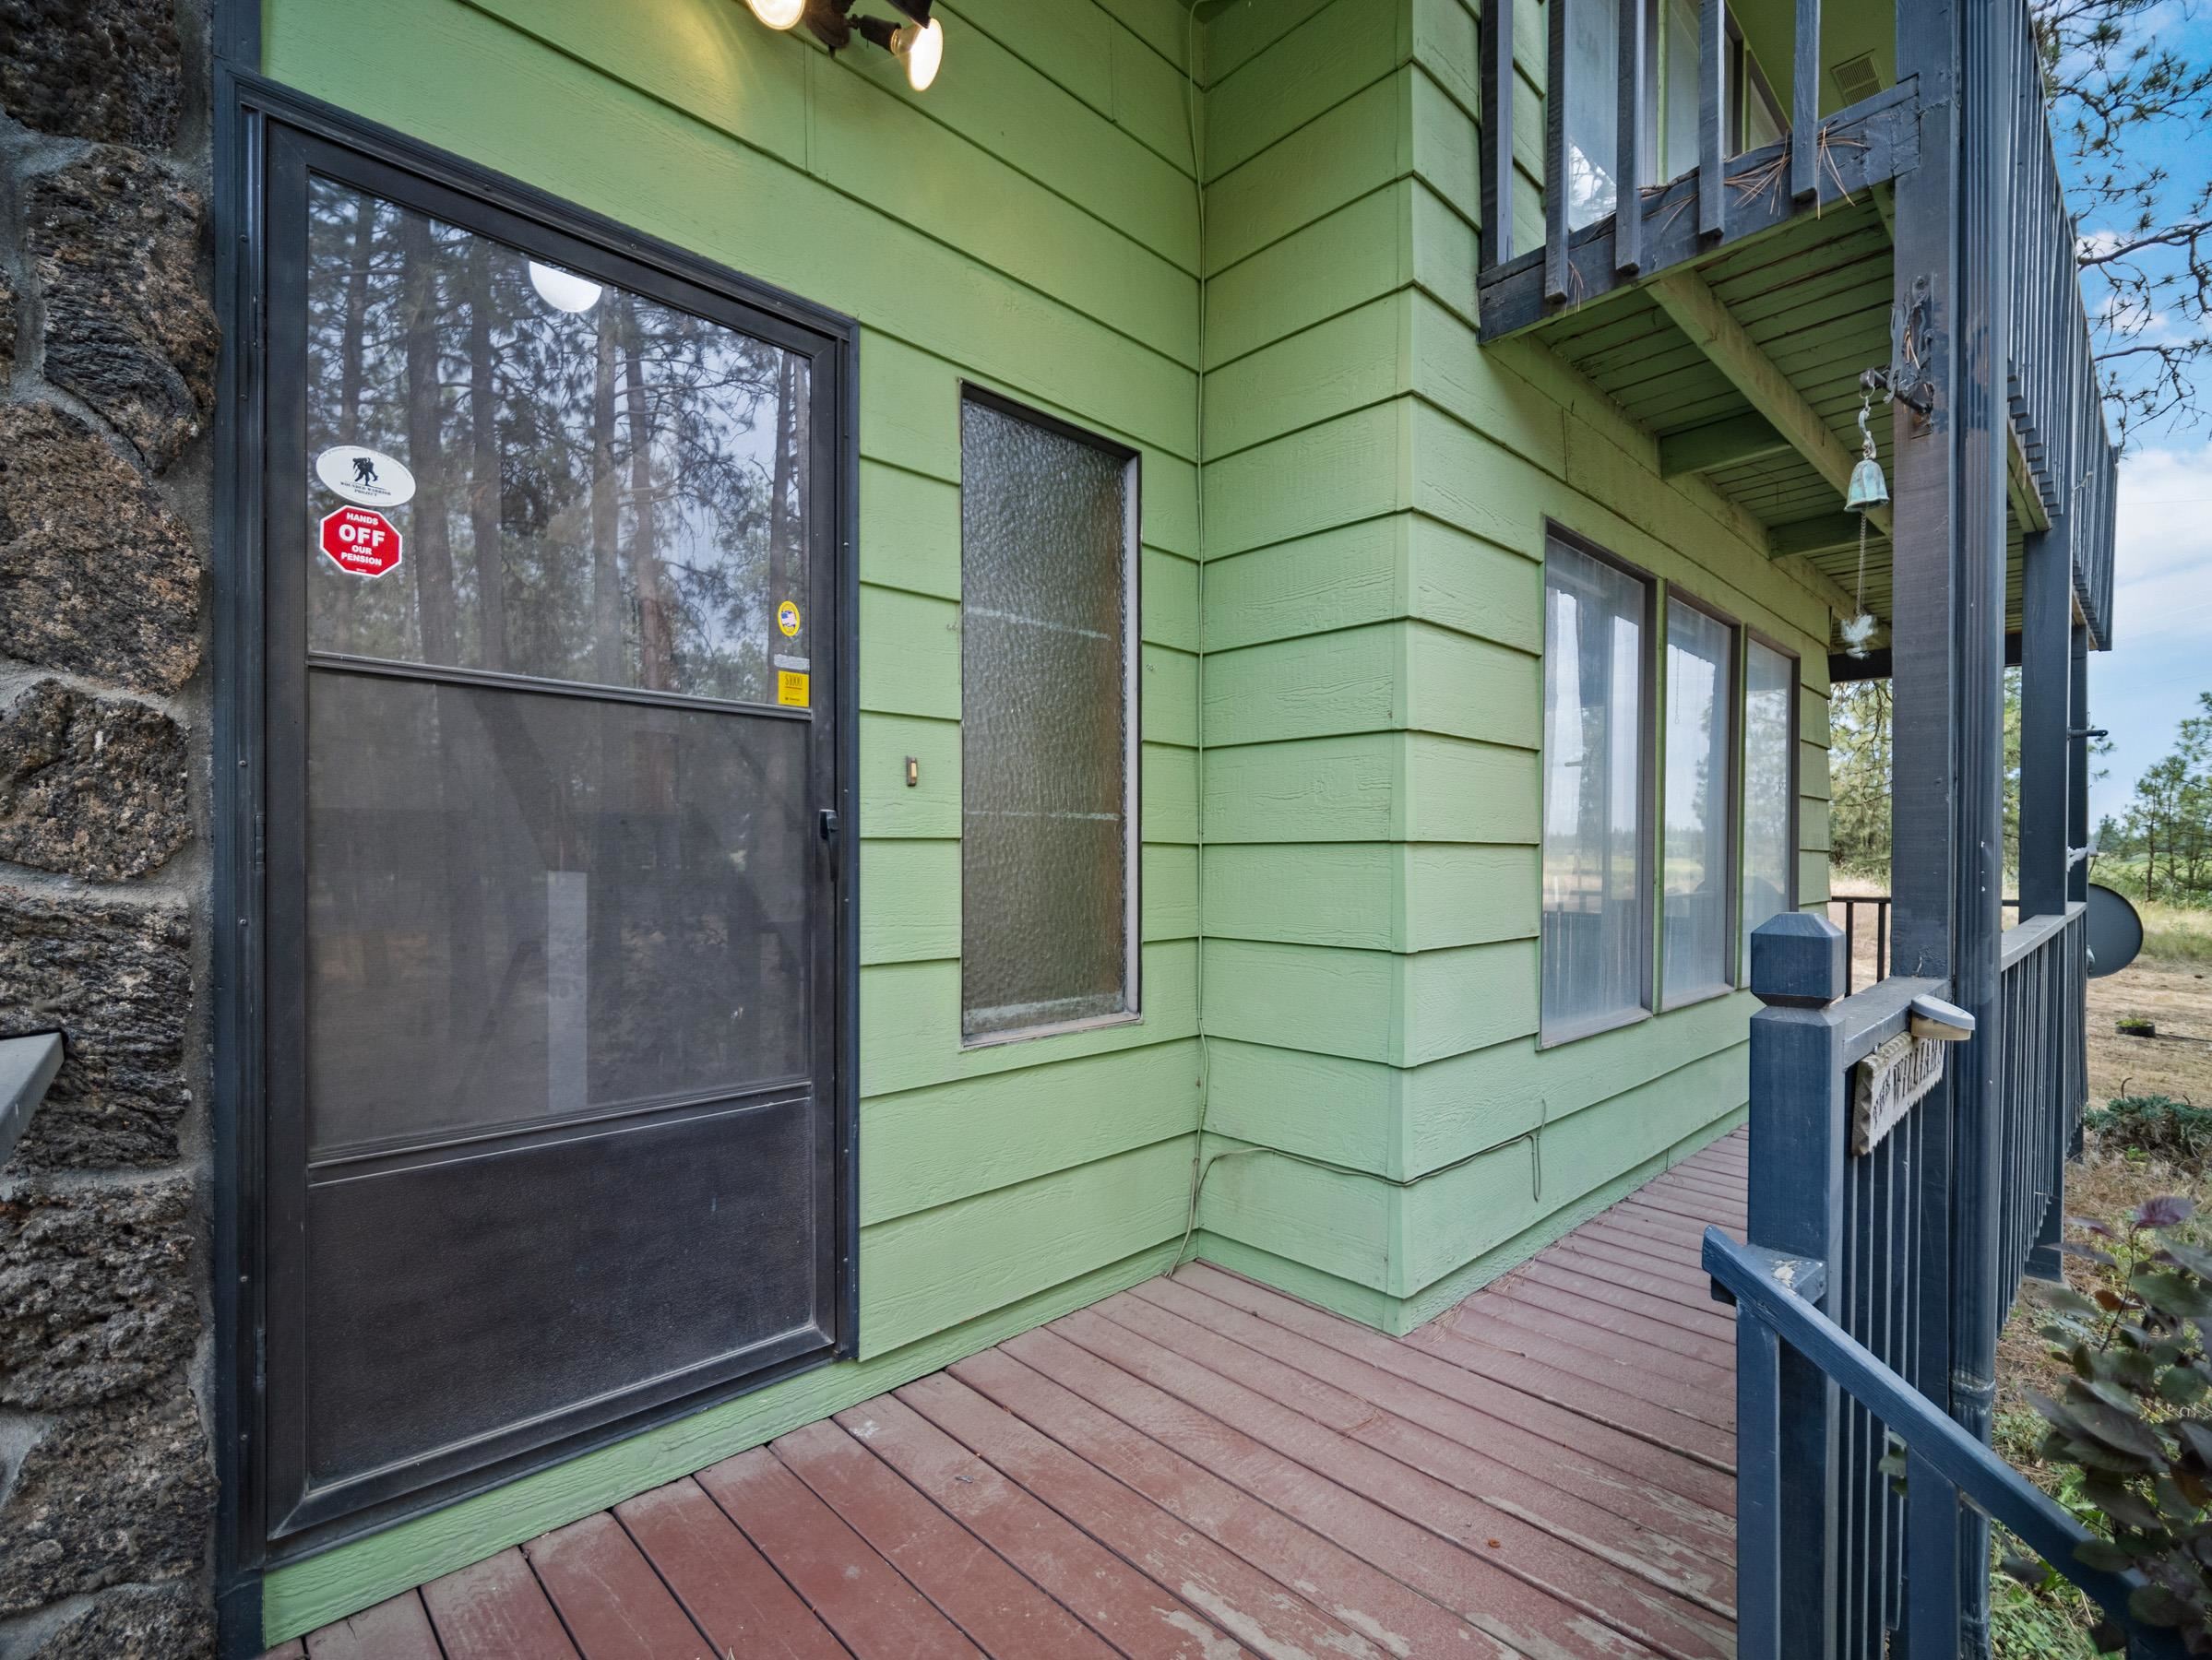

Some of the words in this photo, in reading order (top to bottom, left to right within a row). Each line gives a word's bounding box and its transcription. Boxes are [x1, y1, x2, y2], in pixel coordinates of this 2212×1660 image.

[340, 480, 366, 492] WOUNDED
[367, 487, 392, 496] WARRIOR
[354, 489, 377, 497] PROJECT
[346, 512, 379, 526] HANDS
[339, 524, 386, 547] OFF
[351, 545, 373, 554] OUR
[340, 551, 383, 566] PENSION
